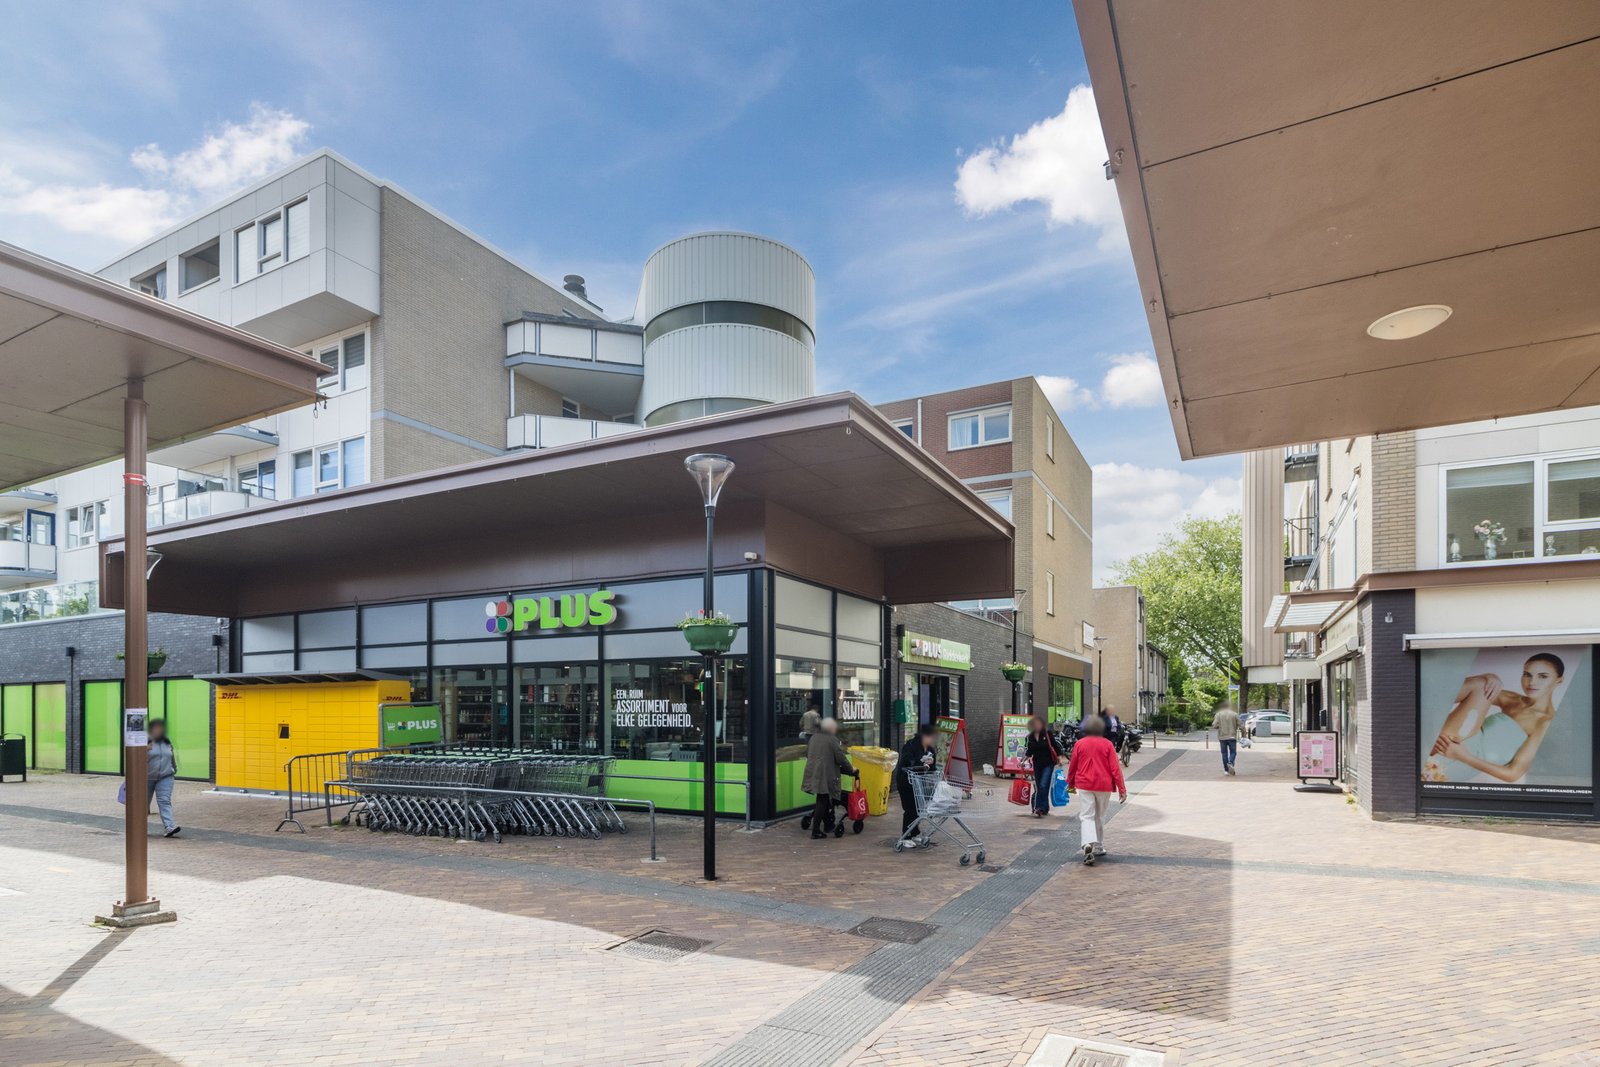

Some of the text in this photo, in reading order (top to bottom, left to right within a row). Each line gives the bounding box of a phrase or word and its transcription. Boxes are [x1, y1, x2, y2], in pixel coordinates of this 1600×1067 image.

[514, 590, 618, 632] PLUS
[922, 641, 942, 659] PLUS
[616, 689, 643, 699] EEN RUIM
[616, 699, 687, 713] ASSORTIMENT VOOR
[842, 700, 874, 720] SLIJTERIJ
[406, 719, 438, 730] PLUS
[616, 713, 694, 728] ELKE GELEGENHEID.
[940, 721, 959, 731] PLUS
